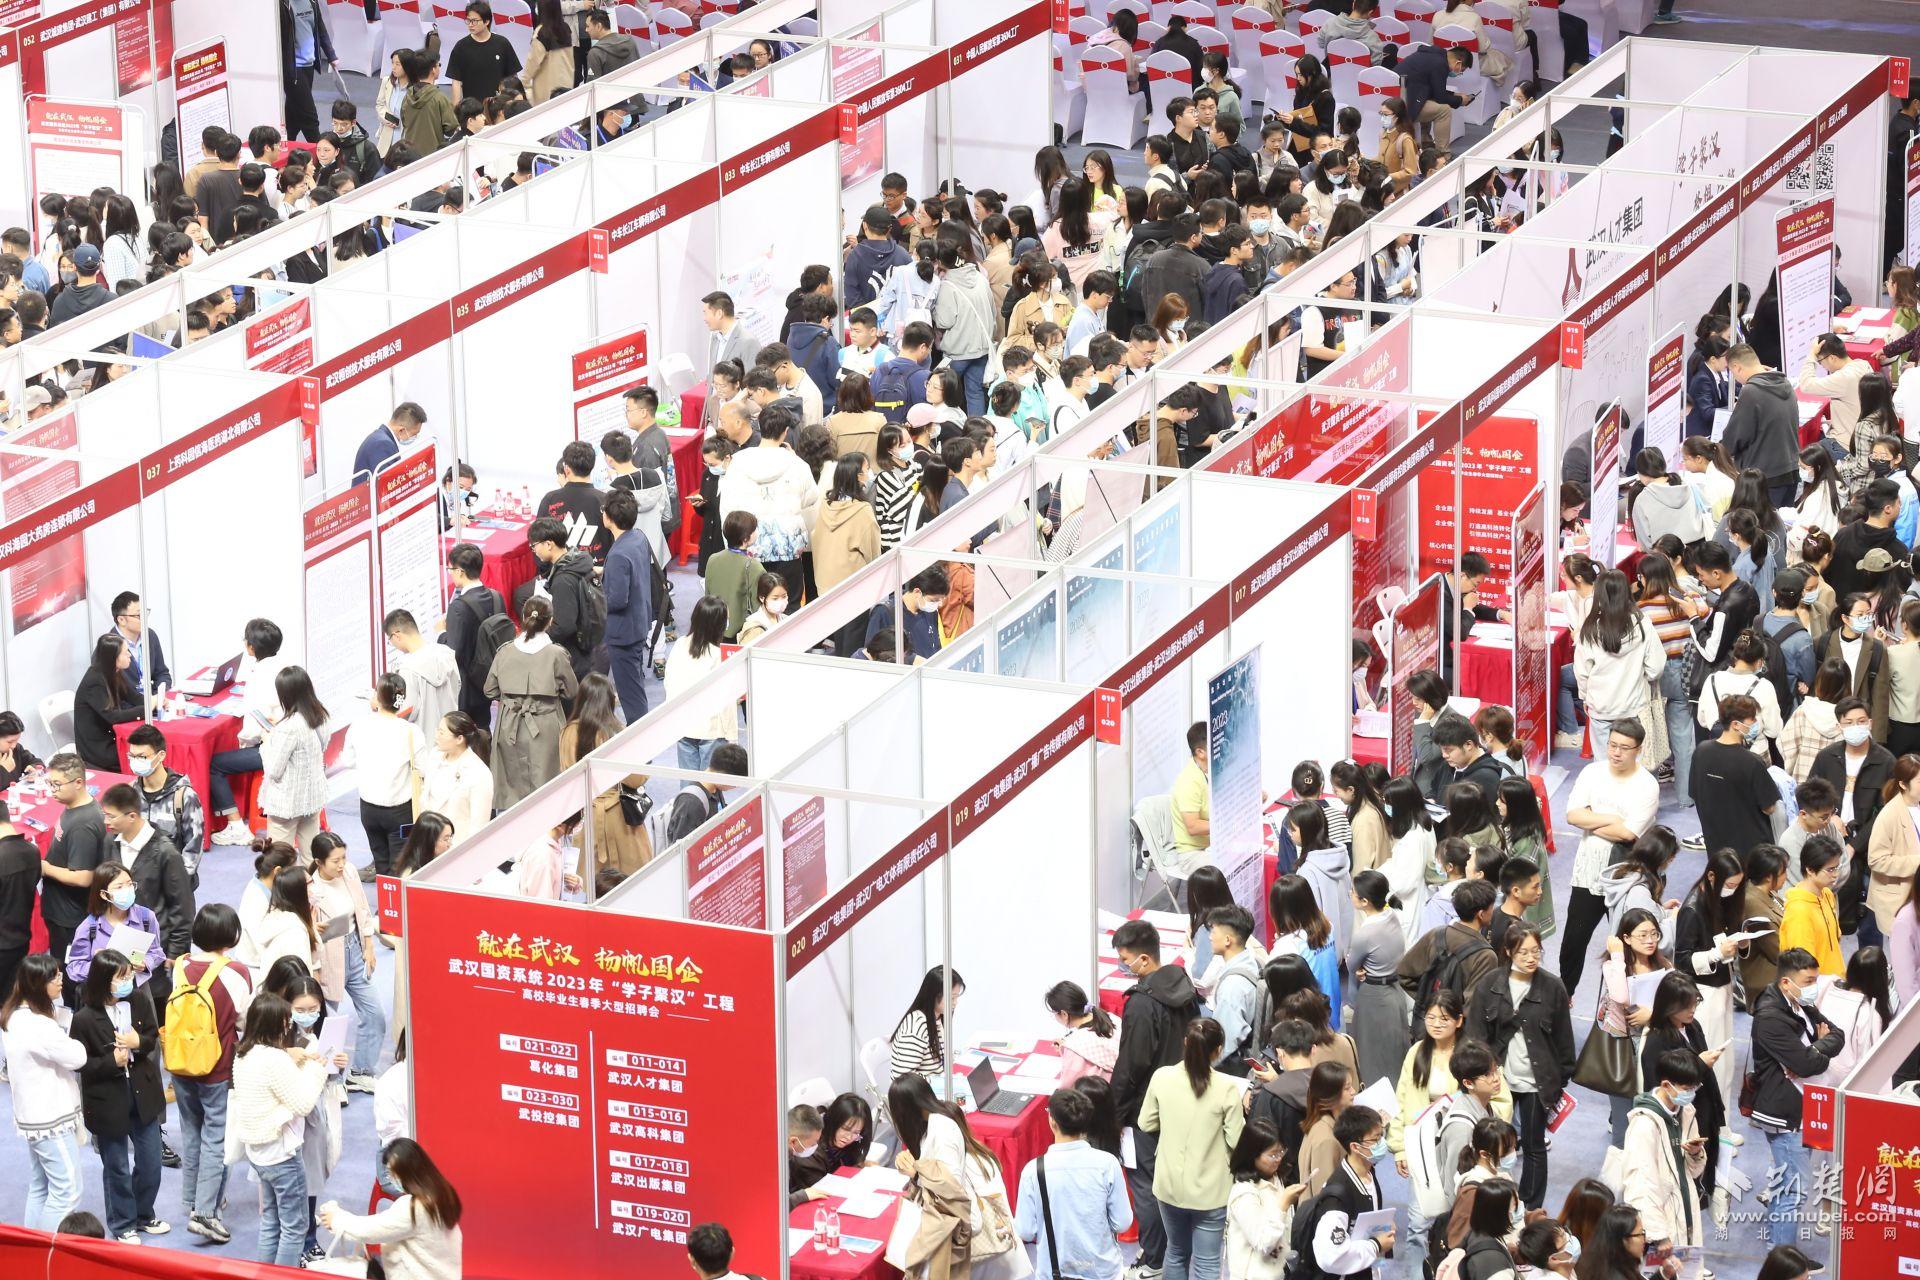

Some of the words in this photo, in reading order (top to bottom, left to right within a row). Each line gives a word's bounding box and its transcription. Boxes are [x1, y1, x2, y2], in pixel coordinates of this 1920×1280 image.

[724, 169, 736, 182] 033
[456, 303, 469, 318] 035
[1465, 405, 1475, 421] 015
[146, 463, 161, 481] 037
[1357, 494, 1371, 502] 017
[1234, 585, 1247, 603] 017
[1101, 694, 1115, 703] 019
[1101, 718, 1115, 727] 020
[1212, 710, 1228, 733] 2023
[955, 807, 969, 827] 019
[383, 882, 397, 892] 021
[384, 909, 399, 919] 022
[791, 937, 806, 958] 020
[475, 929, 580, 967] 就在武汉
[593, 946, 703, 985] 扬帆国企
[522, 988, 660, 1018] 高校毕业生春季大型招聘会
[524, 1040, 572, 1056] 021-022
[529, 1059, 579, 1079] 葛化集团
[631, 1055, 681, 1072] 011-014
[607, 1071, 683, 1093] 武汉人才集团
[526, 1091, 574, 1107] 023-030
[1810, 1092, 1828, 1102] 001
[518, 1108, 580, 1128] 武投控集团
[633, 1106, 682, 1122] 015-016
[609, 1121, 685, 1144] 武汉高科集团
[1810, 1121, 1828, 1131] 010
[634, 1156, 683, 1173] 017-018
[610, 1172, 686, 1194] 武汉出版集团
[636, 1206, 685, 1223] 019-020
[612, 1222, 687, 1245] 武汉广电集团
